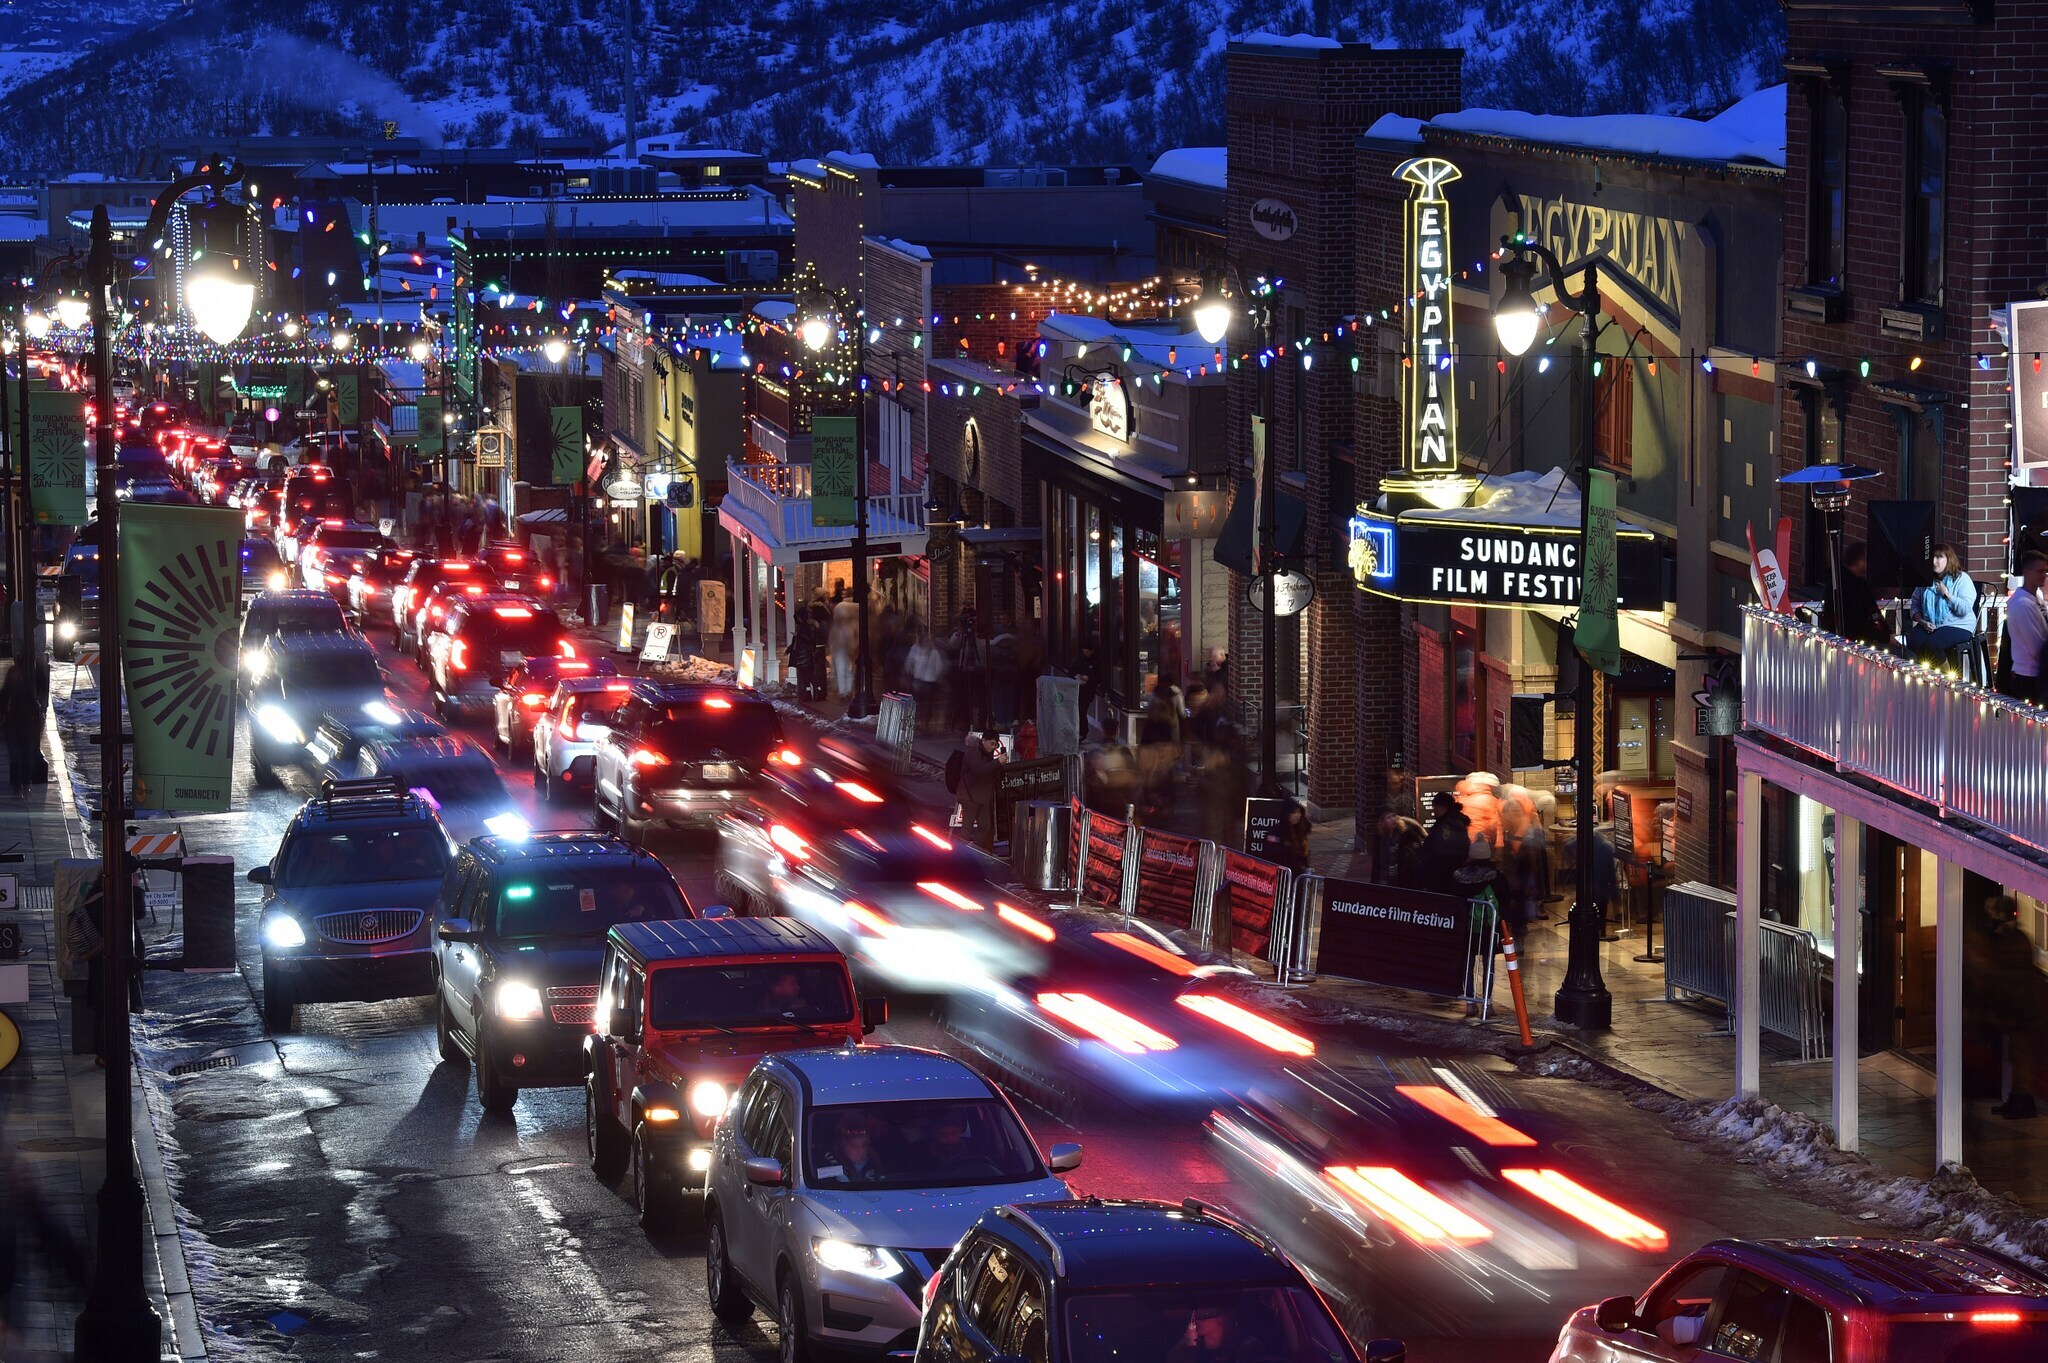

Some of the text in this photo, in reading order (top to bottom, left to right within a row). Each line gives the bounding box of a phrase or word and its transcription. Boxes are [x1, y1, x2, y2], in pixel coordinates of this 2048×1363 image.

[1518, 193, 1687, 316] EGYPTIAN
[1420, 208, 1447, 463] EGYPTIAN
[32, 415, 83, 423] SUNDANCE
[47, 422, 69, 430] FILM
[37, 428, 78, 436] FESTIVAL
[33, 473, 84, 481] 23 02
[1590, 505, 1616, 521] SUNDANCE
[1596, 517, 1609, 529] FILM
[1591, 526, 1613, 541] FESTIVAL
[1460, 537, 1581, 568] SUNDANC
[1432, 567, 1488, 594] FILM
[1698, 708, 1740, 723] BEAU
[174, 788, 221, 800] SUNDANCETV
[1331, 899, 1455, 930] sundance film festival
